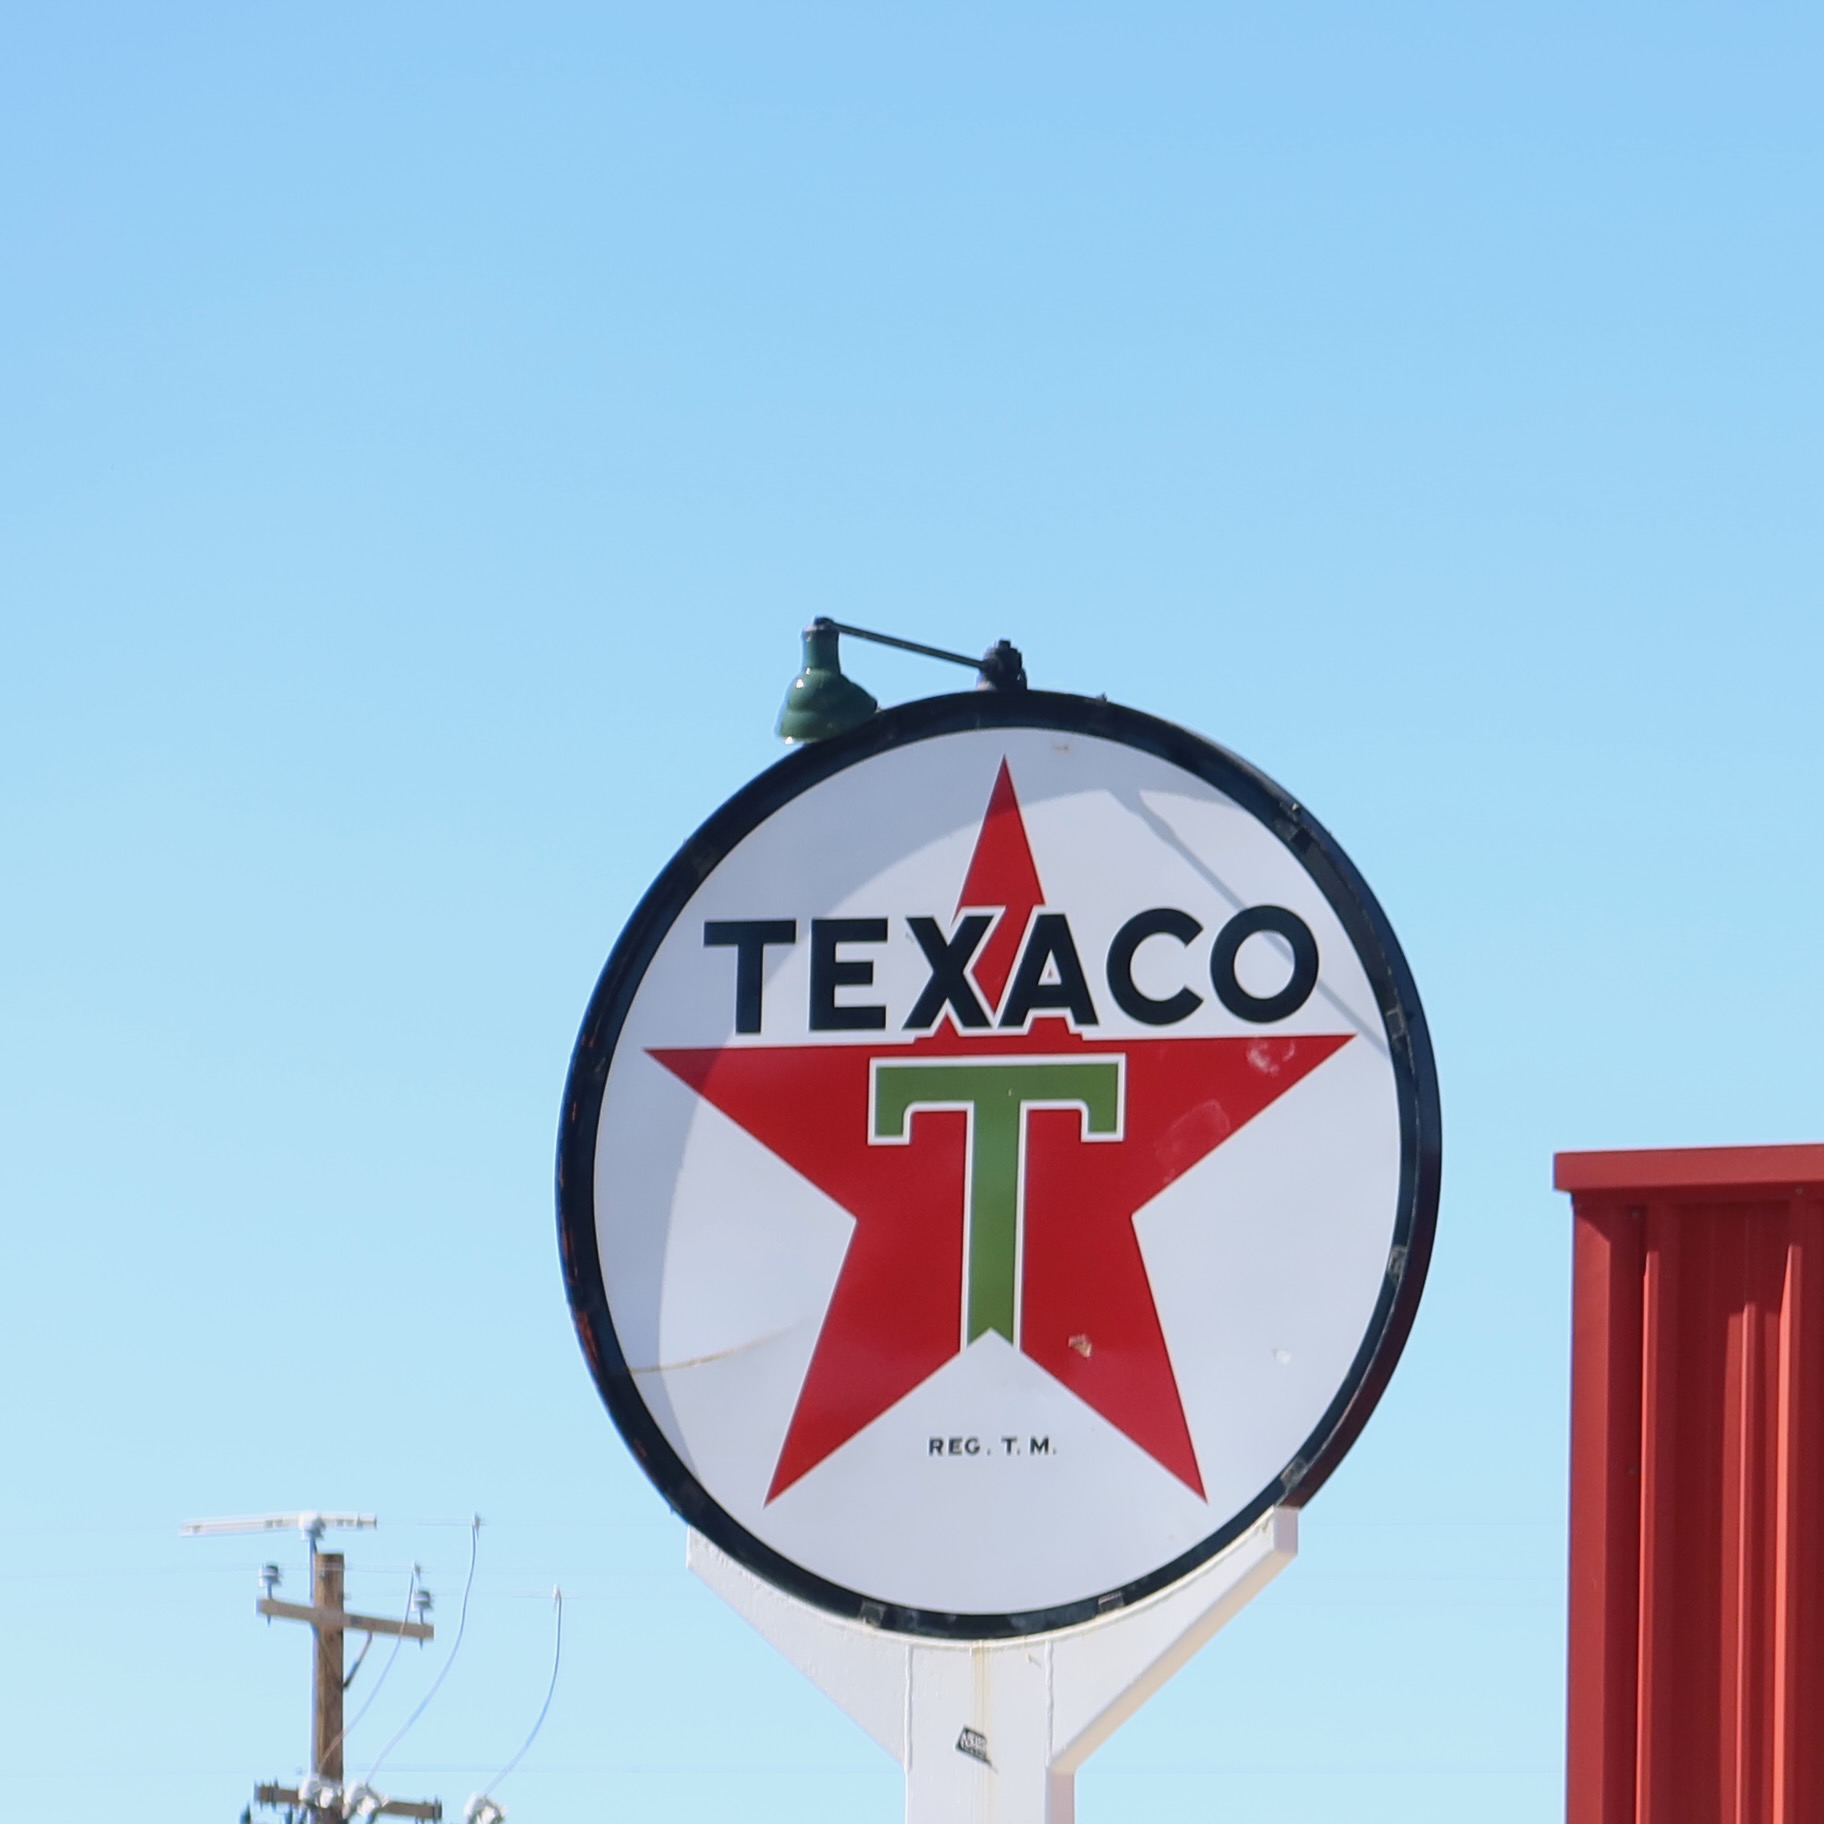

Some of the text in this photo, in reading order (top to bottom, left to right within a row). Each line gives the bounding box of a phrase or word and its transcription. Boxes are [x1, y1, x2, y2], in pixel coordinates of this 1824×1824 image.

[703, 904, 1320, 1034] TEXACO
[868, 1054, 1126, 1352] T
[928, 1437, 991, 1456] REG.
